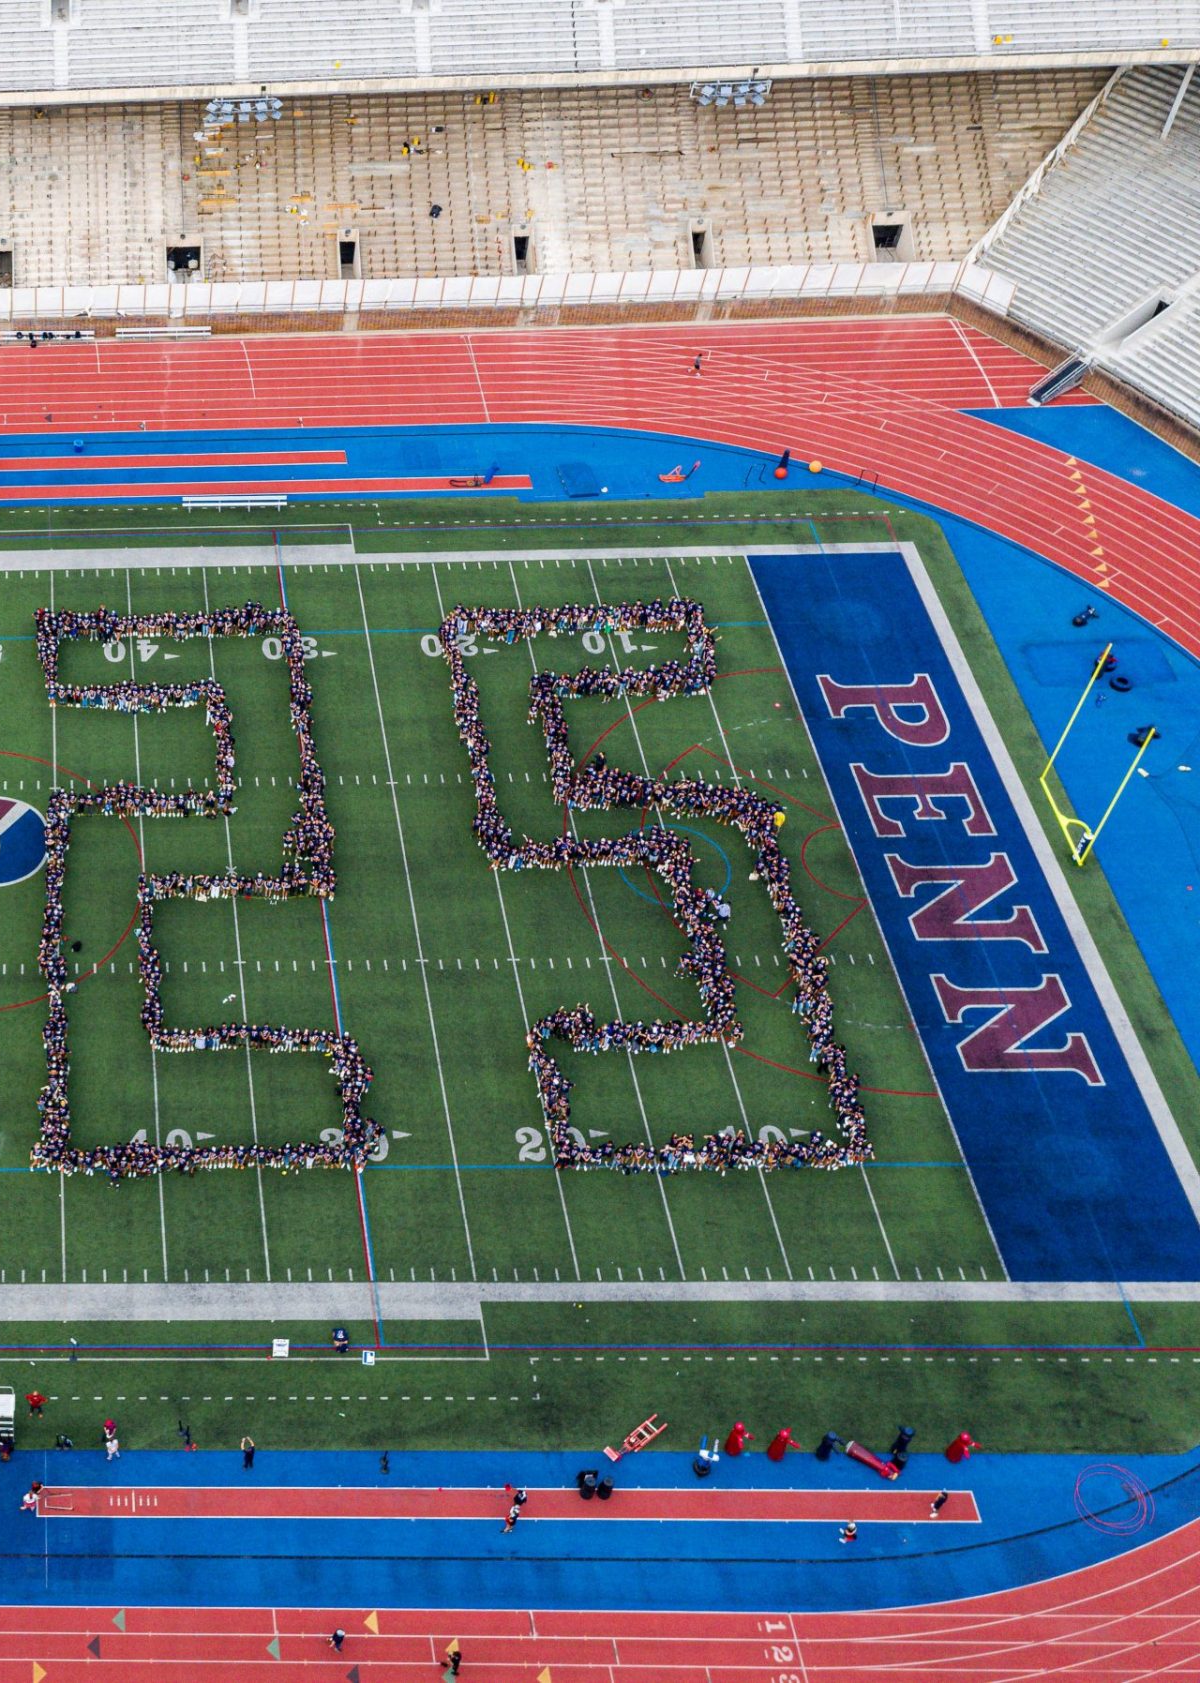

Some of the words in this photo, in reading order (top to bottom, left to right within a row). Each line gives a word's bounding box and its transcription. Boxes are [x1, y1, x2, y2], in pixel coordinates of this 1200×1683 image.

[103, 639, 160, 662] 40
[582, 630, 638, 654] 10
[816, 673, 1106, 1086] PENN
[765, 1620, 786, 1633] 1
[771, 1645, 794, 1663] 2
